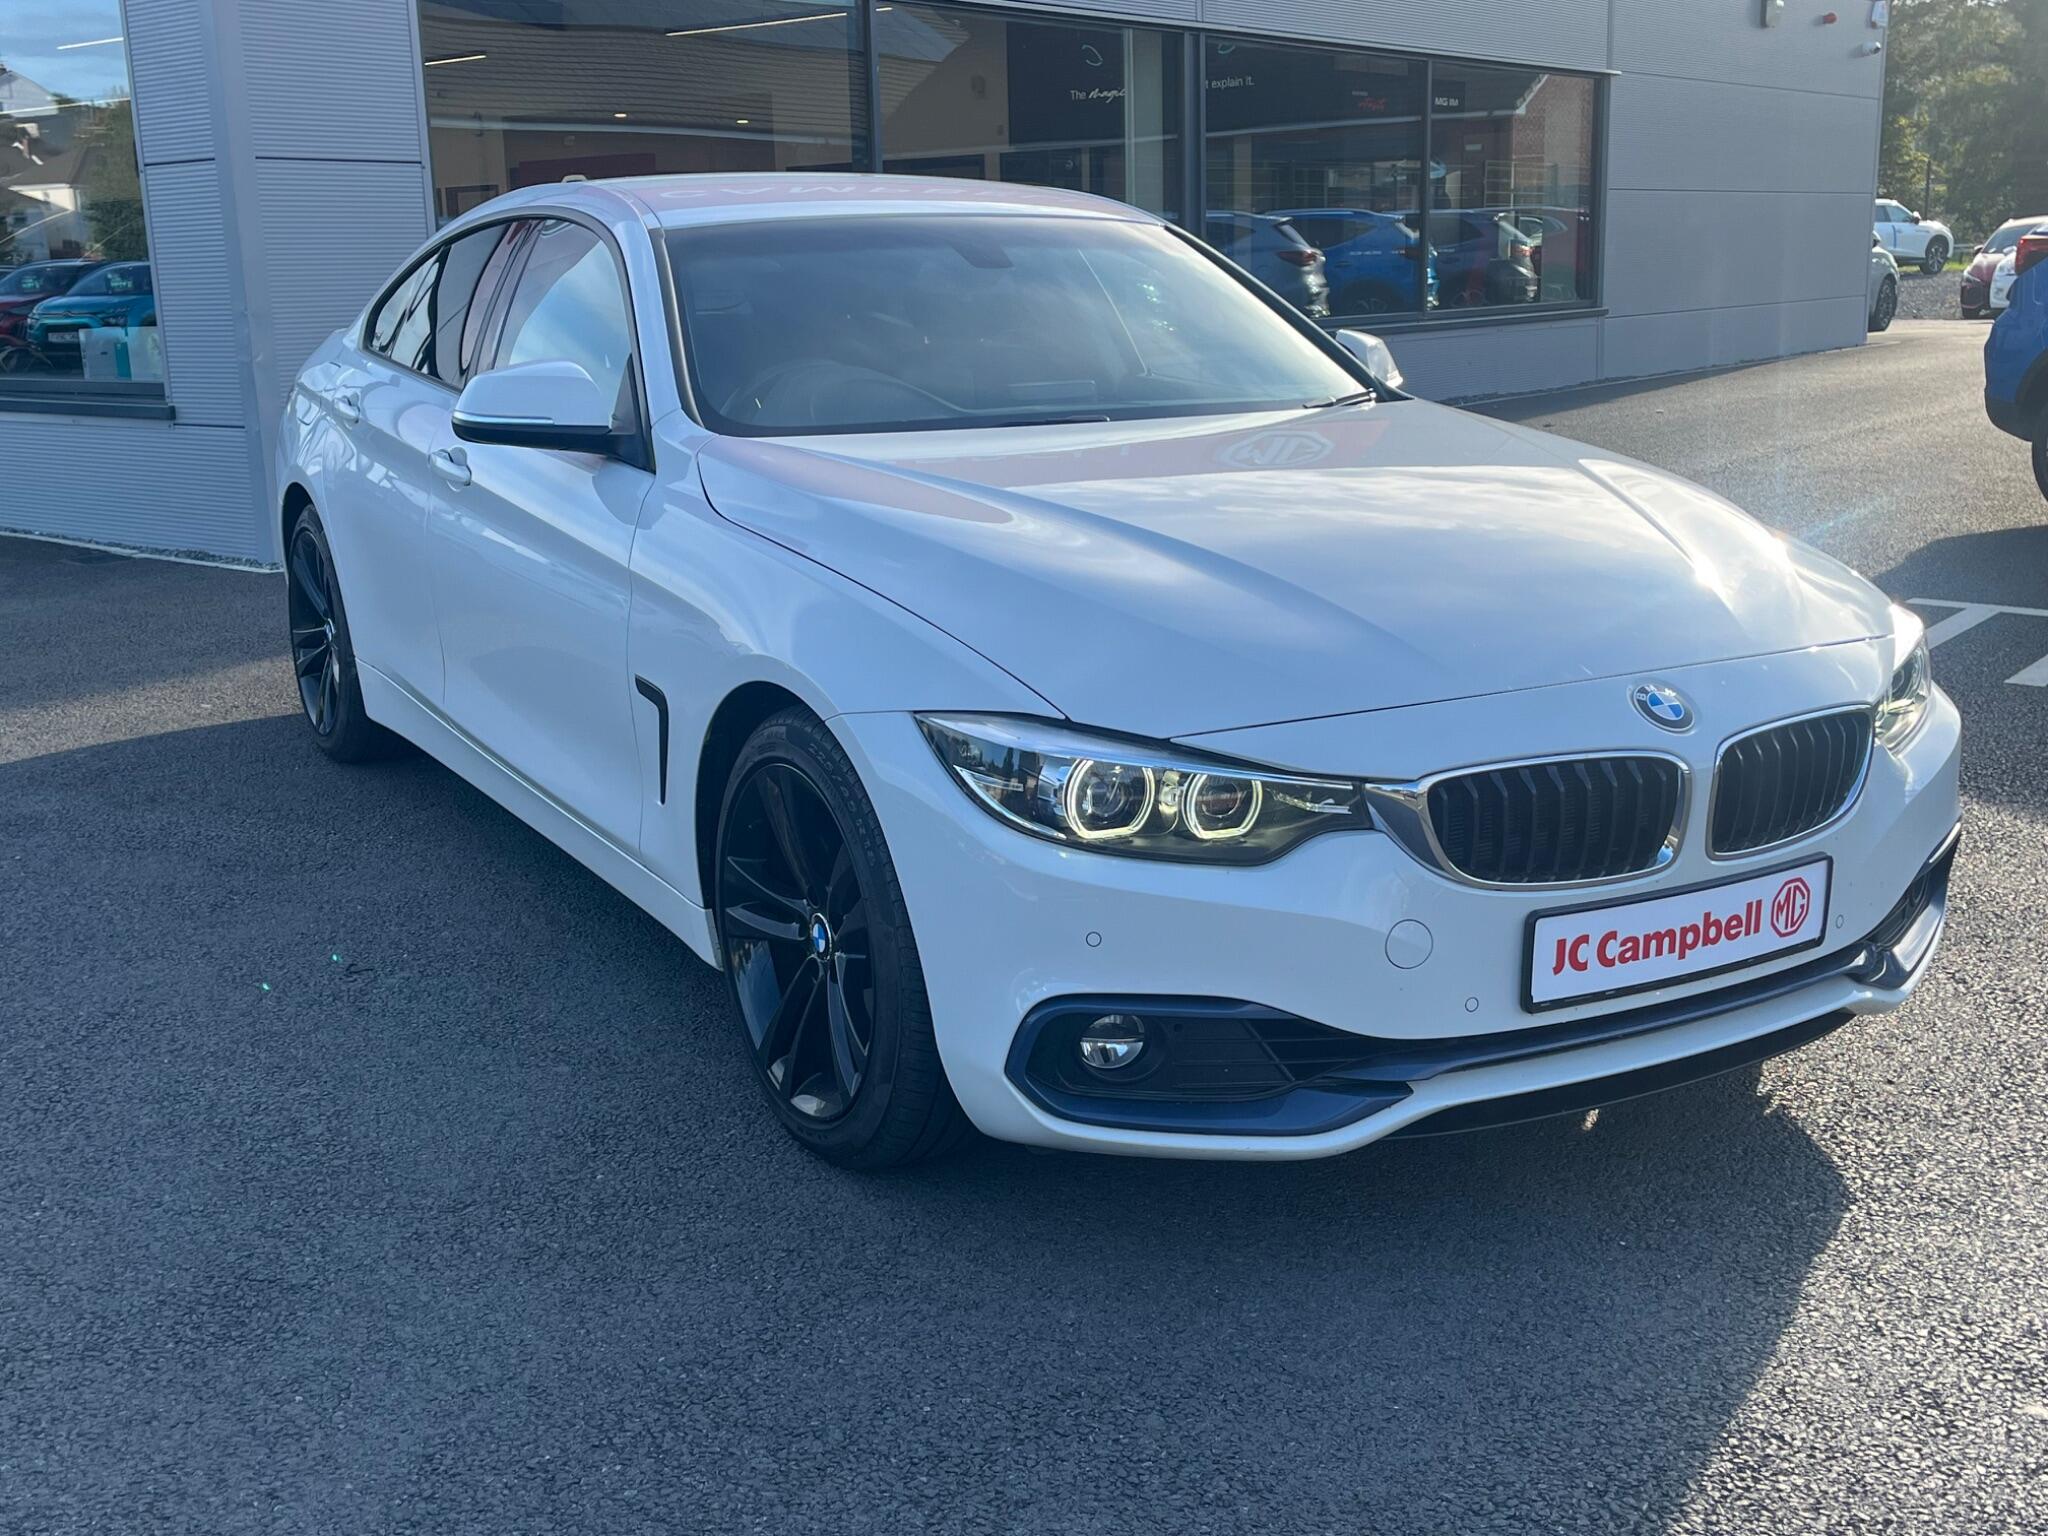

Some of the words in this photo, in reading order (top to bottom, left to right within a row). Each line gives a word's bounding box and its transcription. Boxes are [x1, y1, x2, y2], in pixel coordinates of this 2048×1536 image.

[1211, 76, 1243, 90] explain
[1070, 89, 1087, 101] The
[1552, 934, 1590, 976] JC
[1597, 899, 1763, 967] Campbell
[1773, 881, 1808, 934] MG
